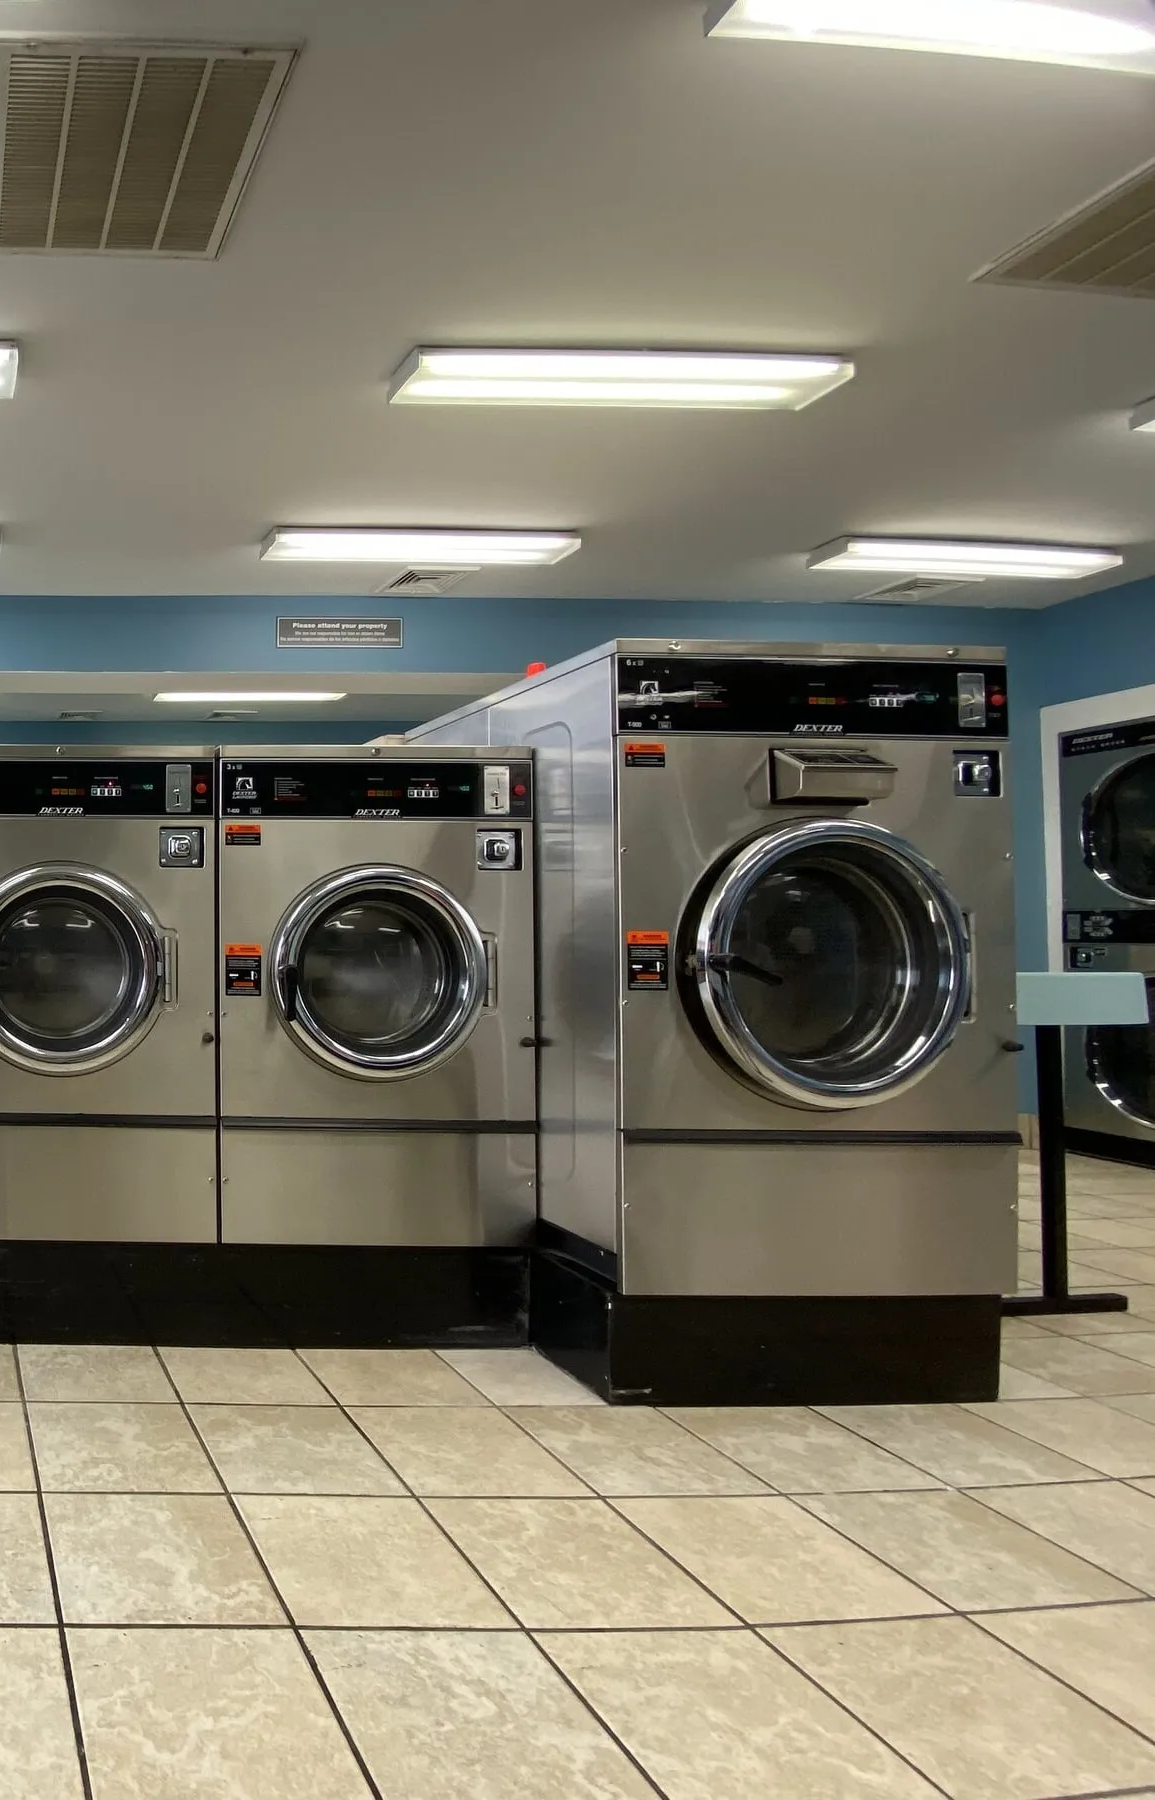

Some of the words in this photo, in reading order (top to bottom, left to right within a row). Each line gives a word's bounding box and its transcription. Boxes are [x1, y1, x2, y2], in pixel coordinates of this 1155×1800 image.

[793, 724, 843, 732] DEXTER
[39, 806, 84, 814] DEXTER
[355, 808, 400, 816] DEXTER
